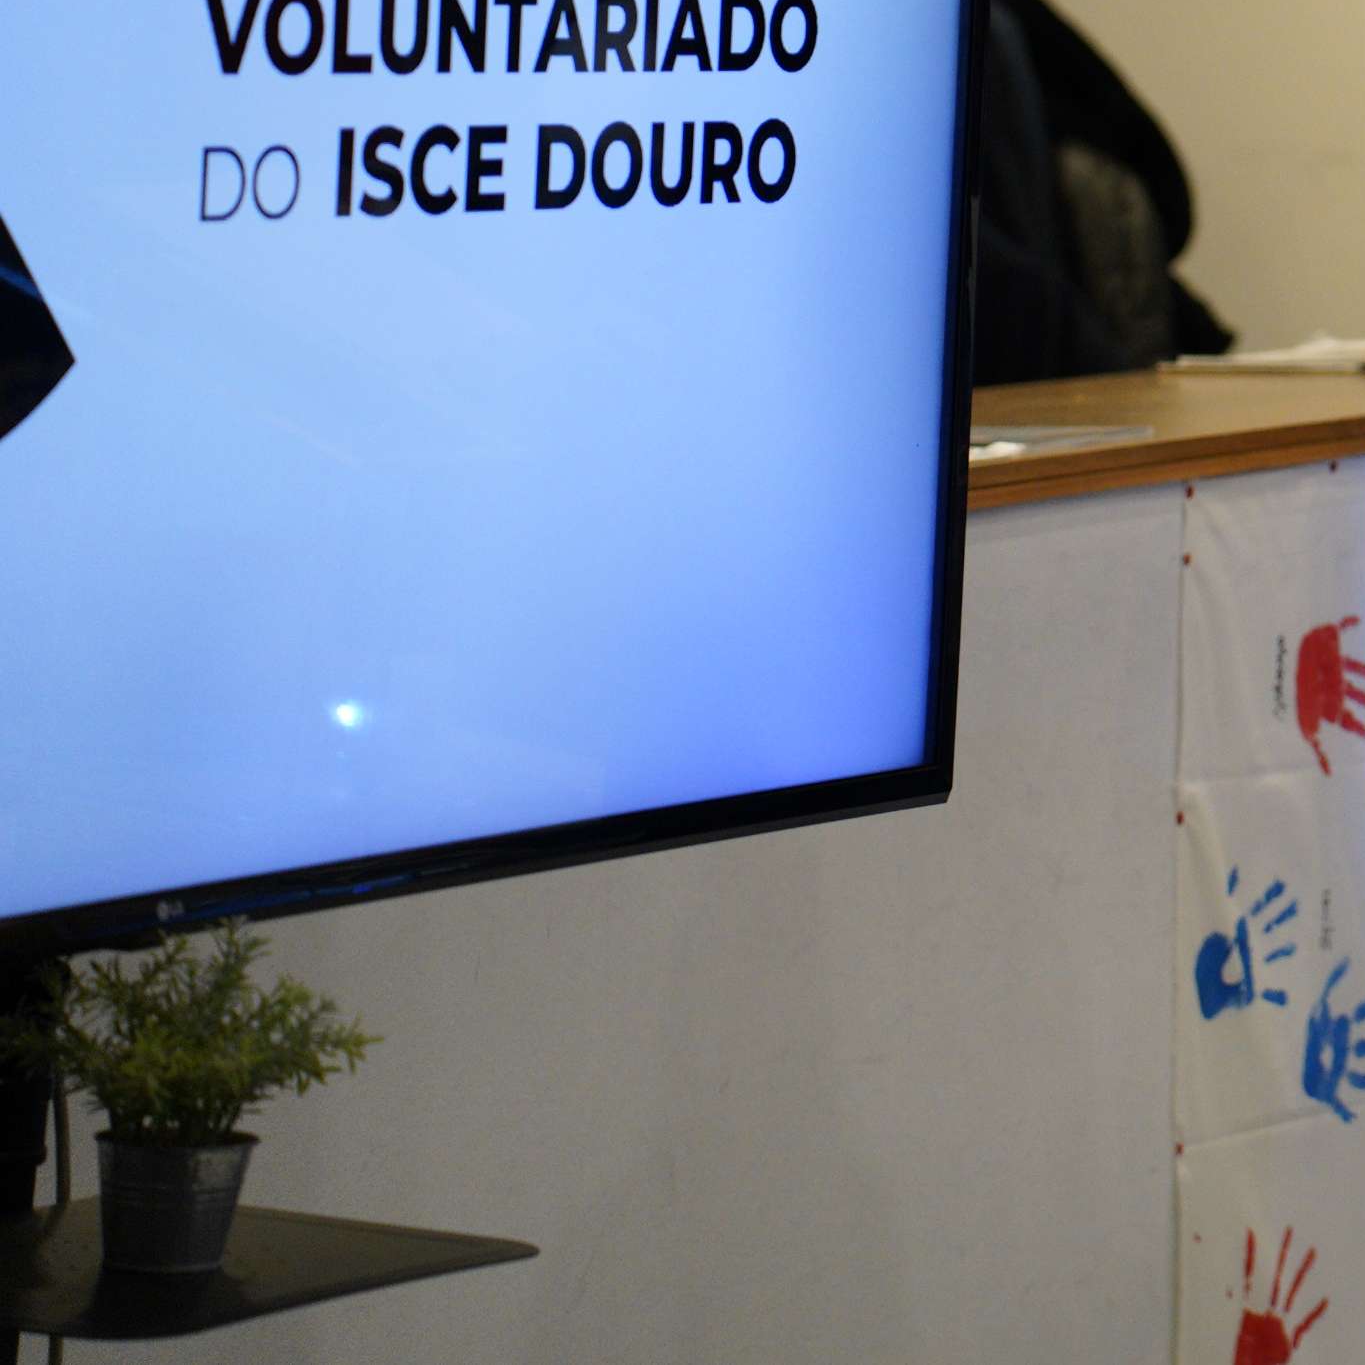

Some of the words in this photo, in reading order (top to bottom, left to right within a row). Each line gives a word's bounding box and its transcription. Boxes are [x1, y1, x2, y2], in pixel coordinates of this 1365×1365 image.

[199, 144, 299, 222] DO
[335, 124, 508, 217] ISCE
[533, 117, 797, 210] DOURO
